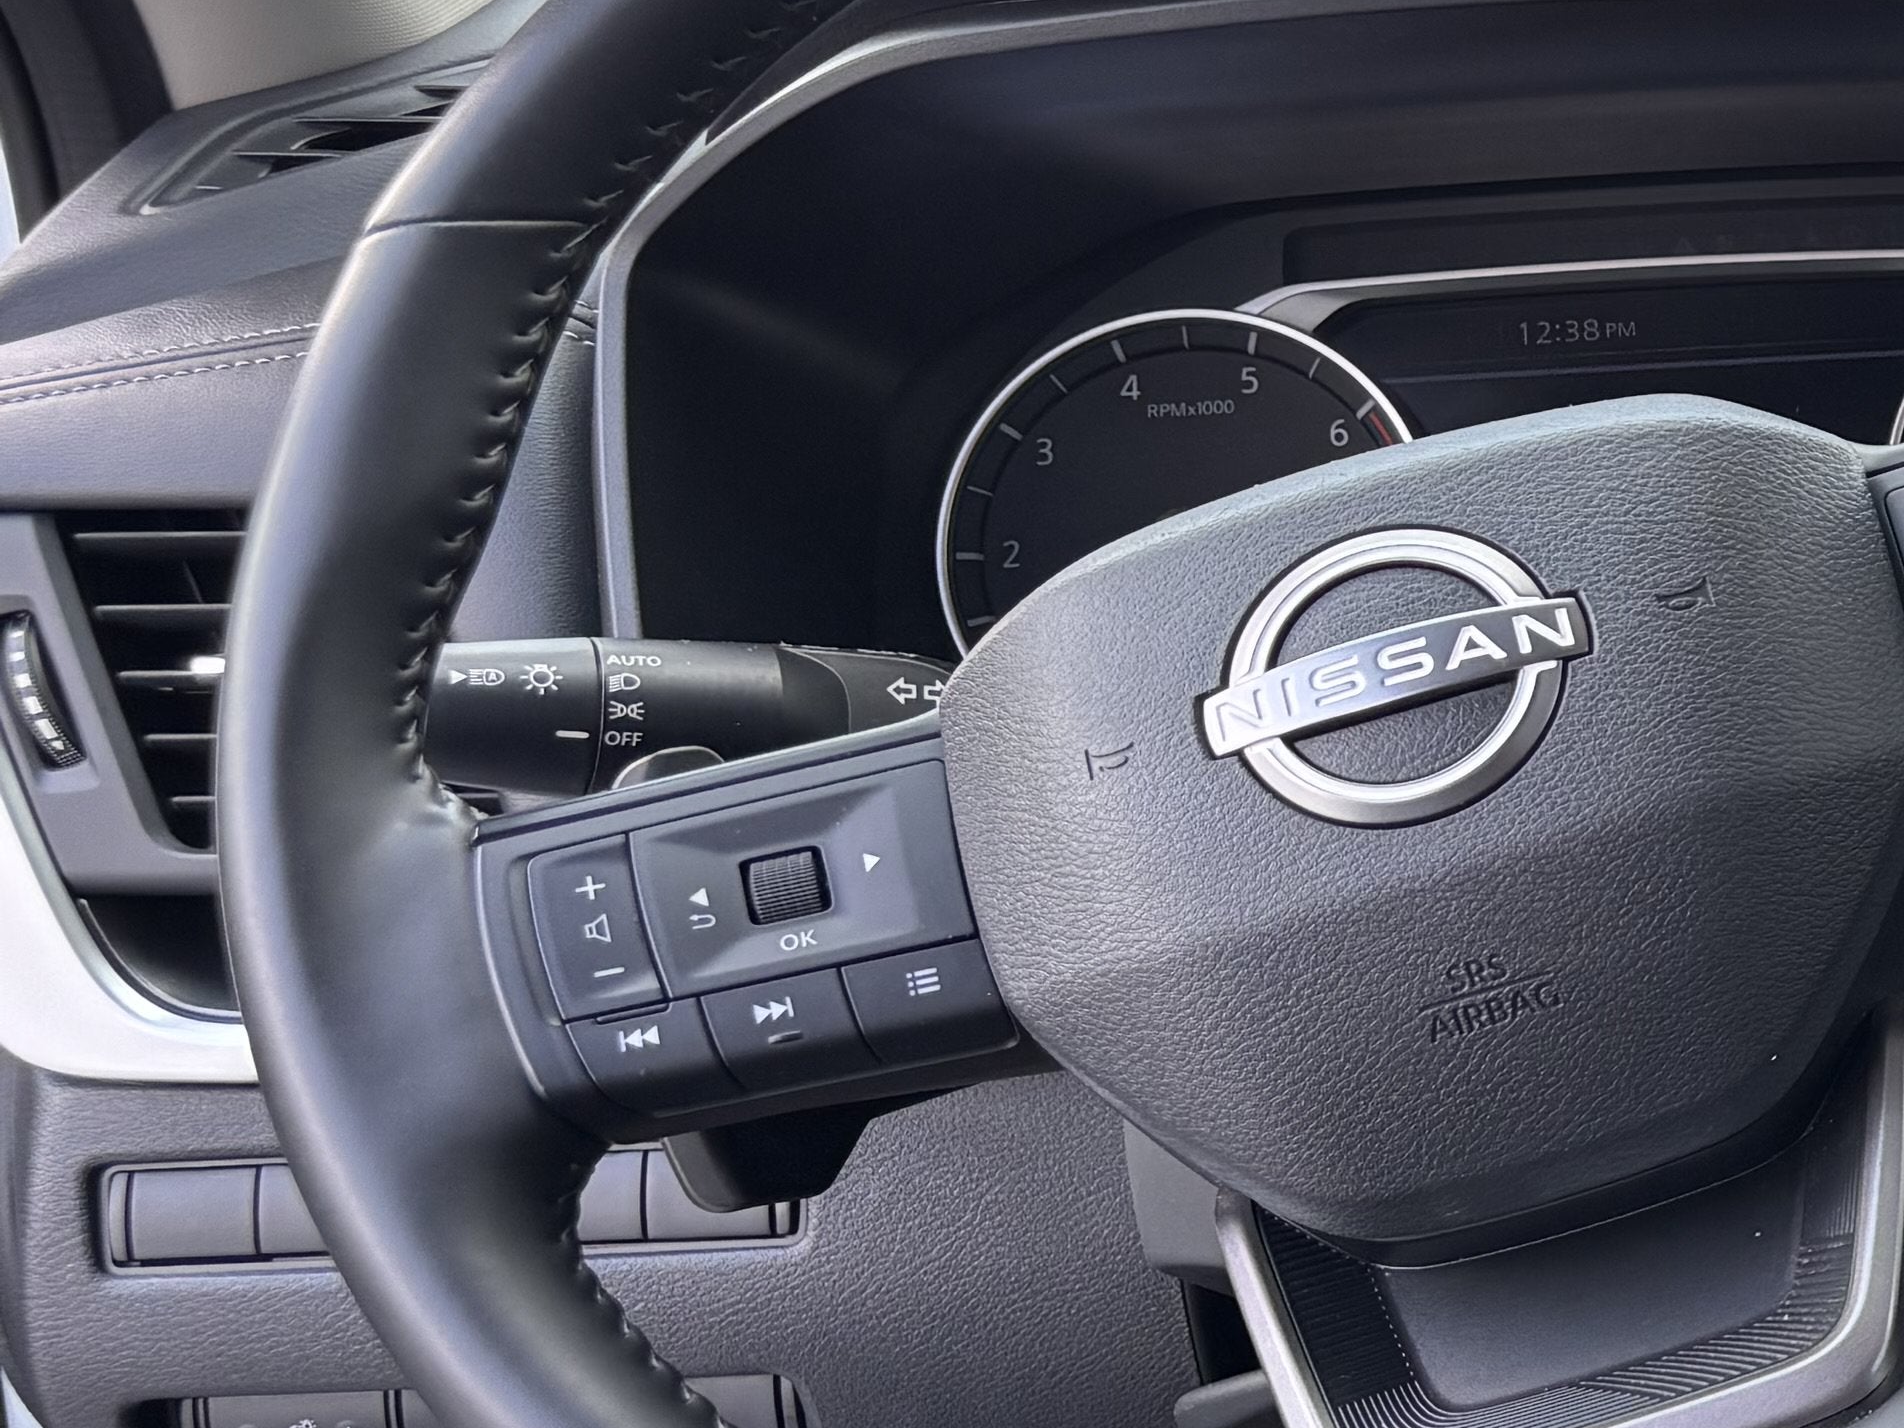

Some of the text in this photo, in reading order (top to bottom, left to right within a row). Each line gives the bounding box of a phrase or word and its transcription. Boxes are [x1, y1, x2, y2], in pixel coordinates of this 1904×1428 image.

[1520, 319, 1636, 345] 12:38 PM
[1119, 374, 1142, 401] 4
[1240, 366, 1260, 394] 5
[1146, 399, 1236, 419] RPMx1000
[1329, 418, 1350, 448] 6
[1035, 438, 1054, 466] 3
[1002, 540, 1021, 569] 2
[606, 654, 662, 668] AUTO
[1213, 606, 1577, 744] NISSAN
[604, 730, 643, 748] OFF
[779, 930, 818, 954] OK
[1445, 953, 1509, 995] SRS
[1429, 979, 1565, 1044] AIRBAG
